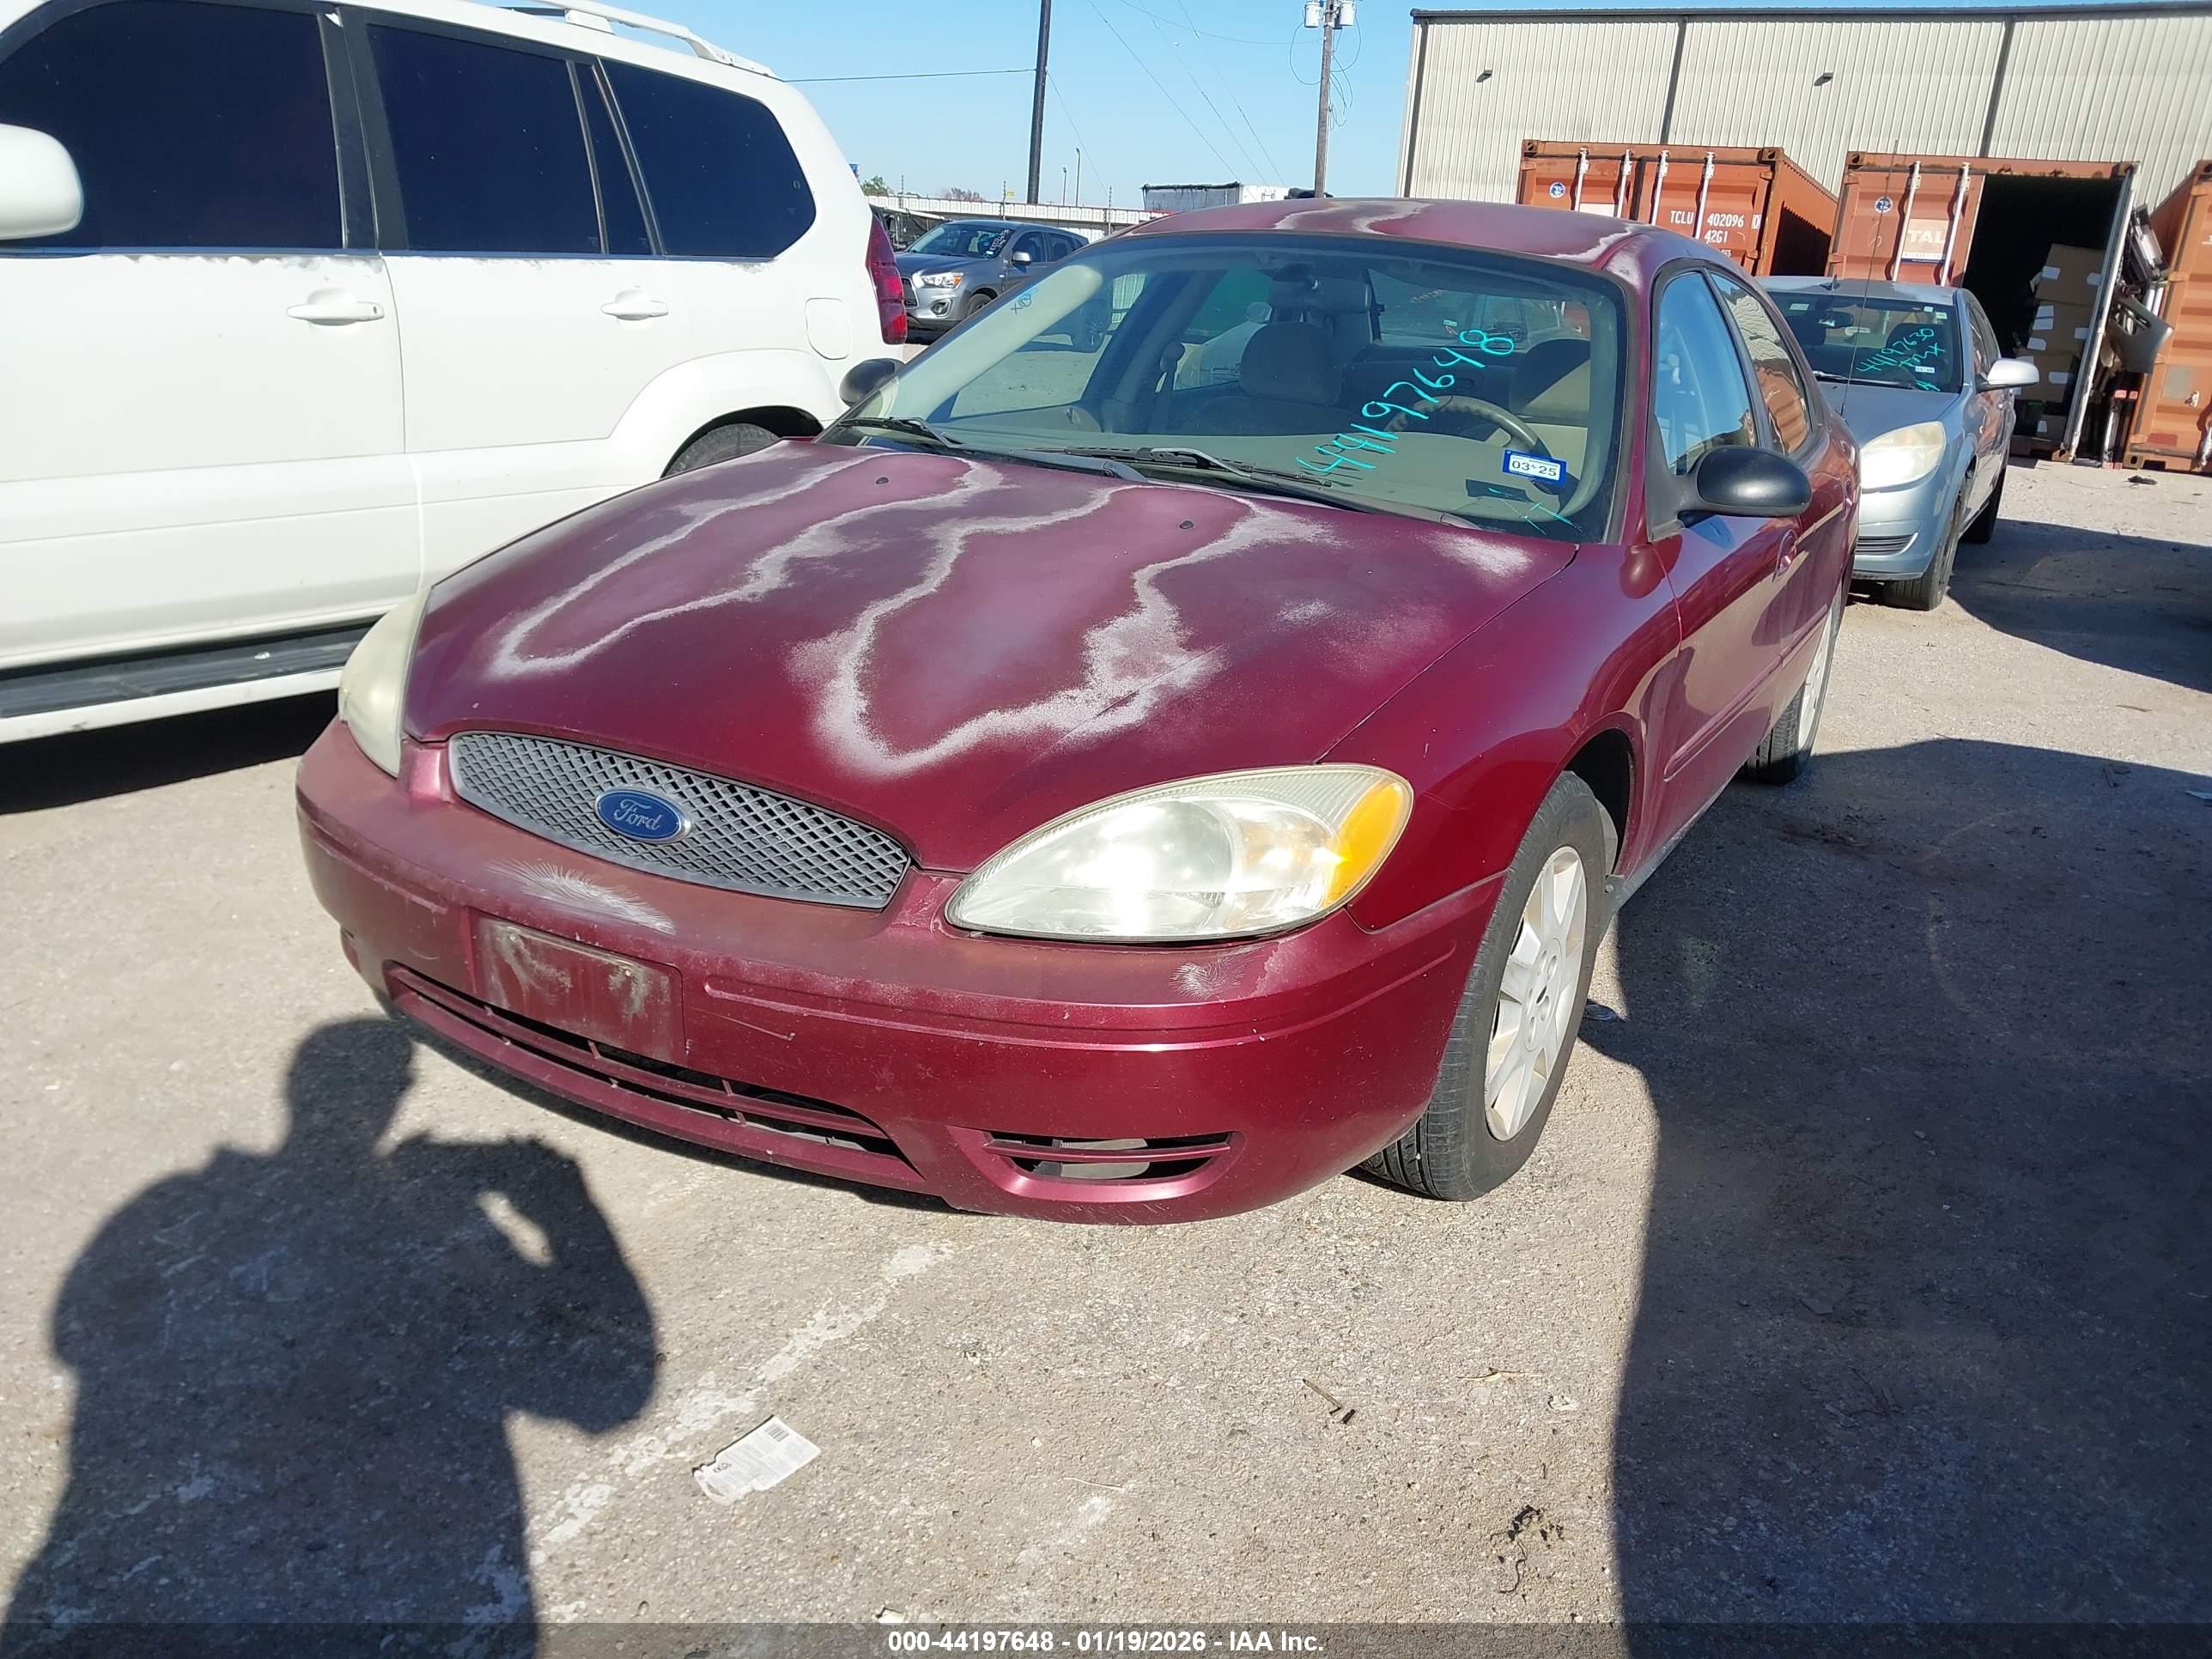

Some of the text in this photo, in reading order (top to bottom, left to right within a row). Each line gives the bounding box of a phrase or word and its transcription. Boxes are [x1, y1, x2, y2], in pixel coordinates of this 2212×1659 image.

[1670, 210, 1694, 224] TCLU
[1707, 213, 1745, 228] 402096
[1705, 229, 1729, 244] 42G1
[1907, 229, 1946, 244] TAL
[1295, 329, 1515, 473] 44197648
[1511, 460, 1557, 477] 03 25
[613, 799, 662, 831] Ford
